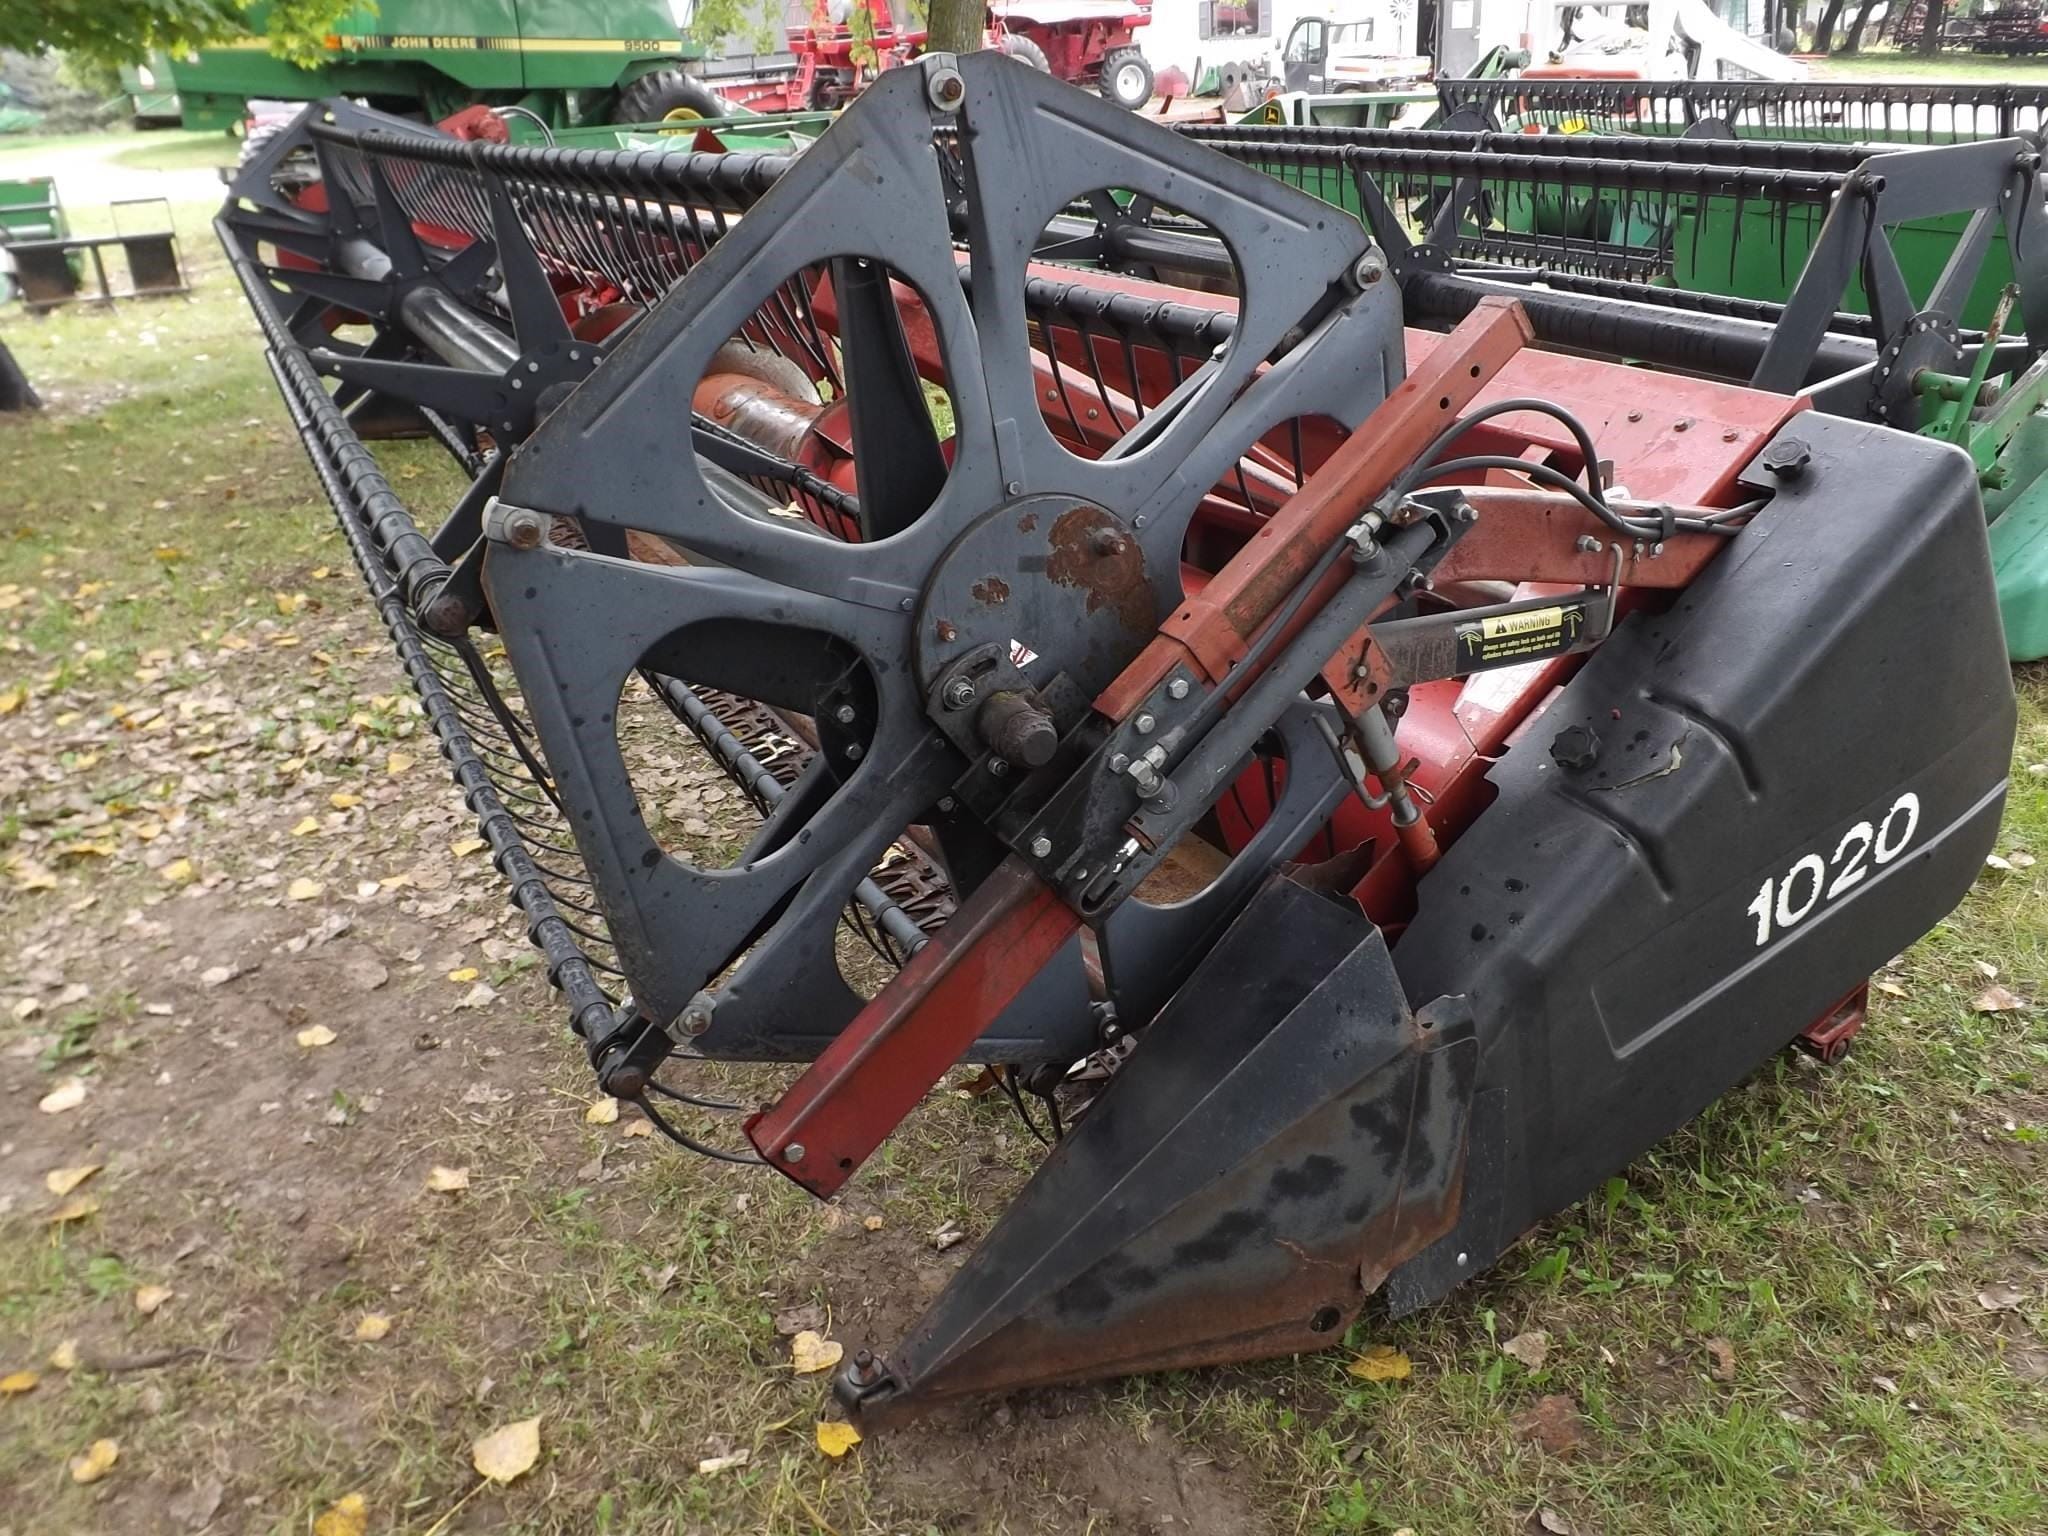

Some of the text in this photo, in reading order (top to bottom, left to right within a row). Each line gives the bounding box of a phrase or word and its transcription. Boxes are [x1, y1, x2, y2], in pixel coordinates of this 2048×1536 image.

[391, 36, 477, 49] JOHN DEERE
[624, 40, 660, 52] 9500
[1509, 615, 1551, 632] WARNING
[1747, 792, 1920, 946] 1020
